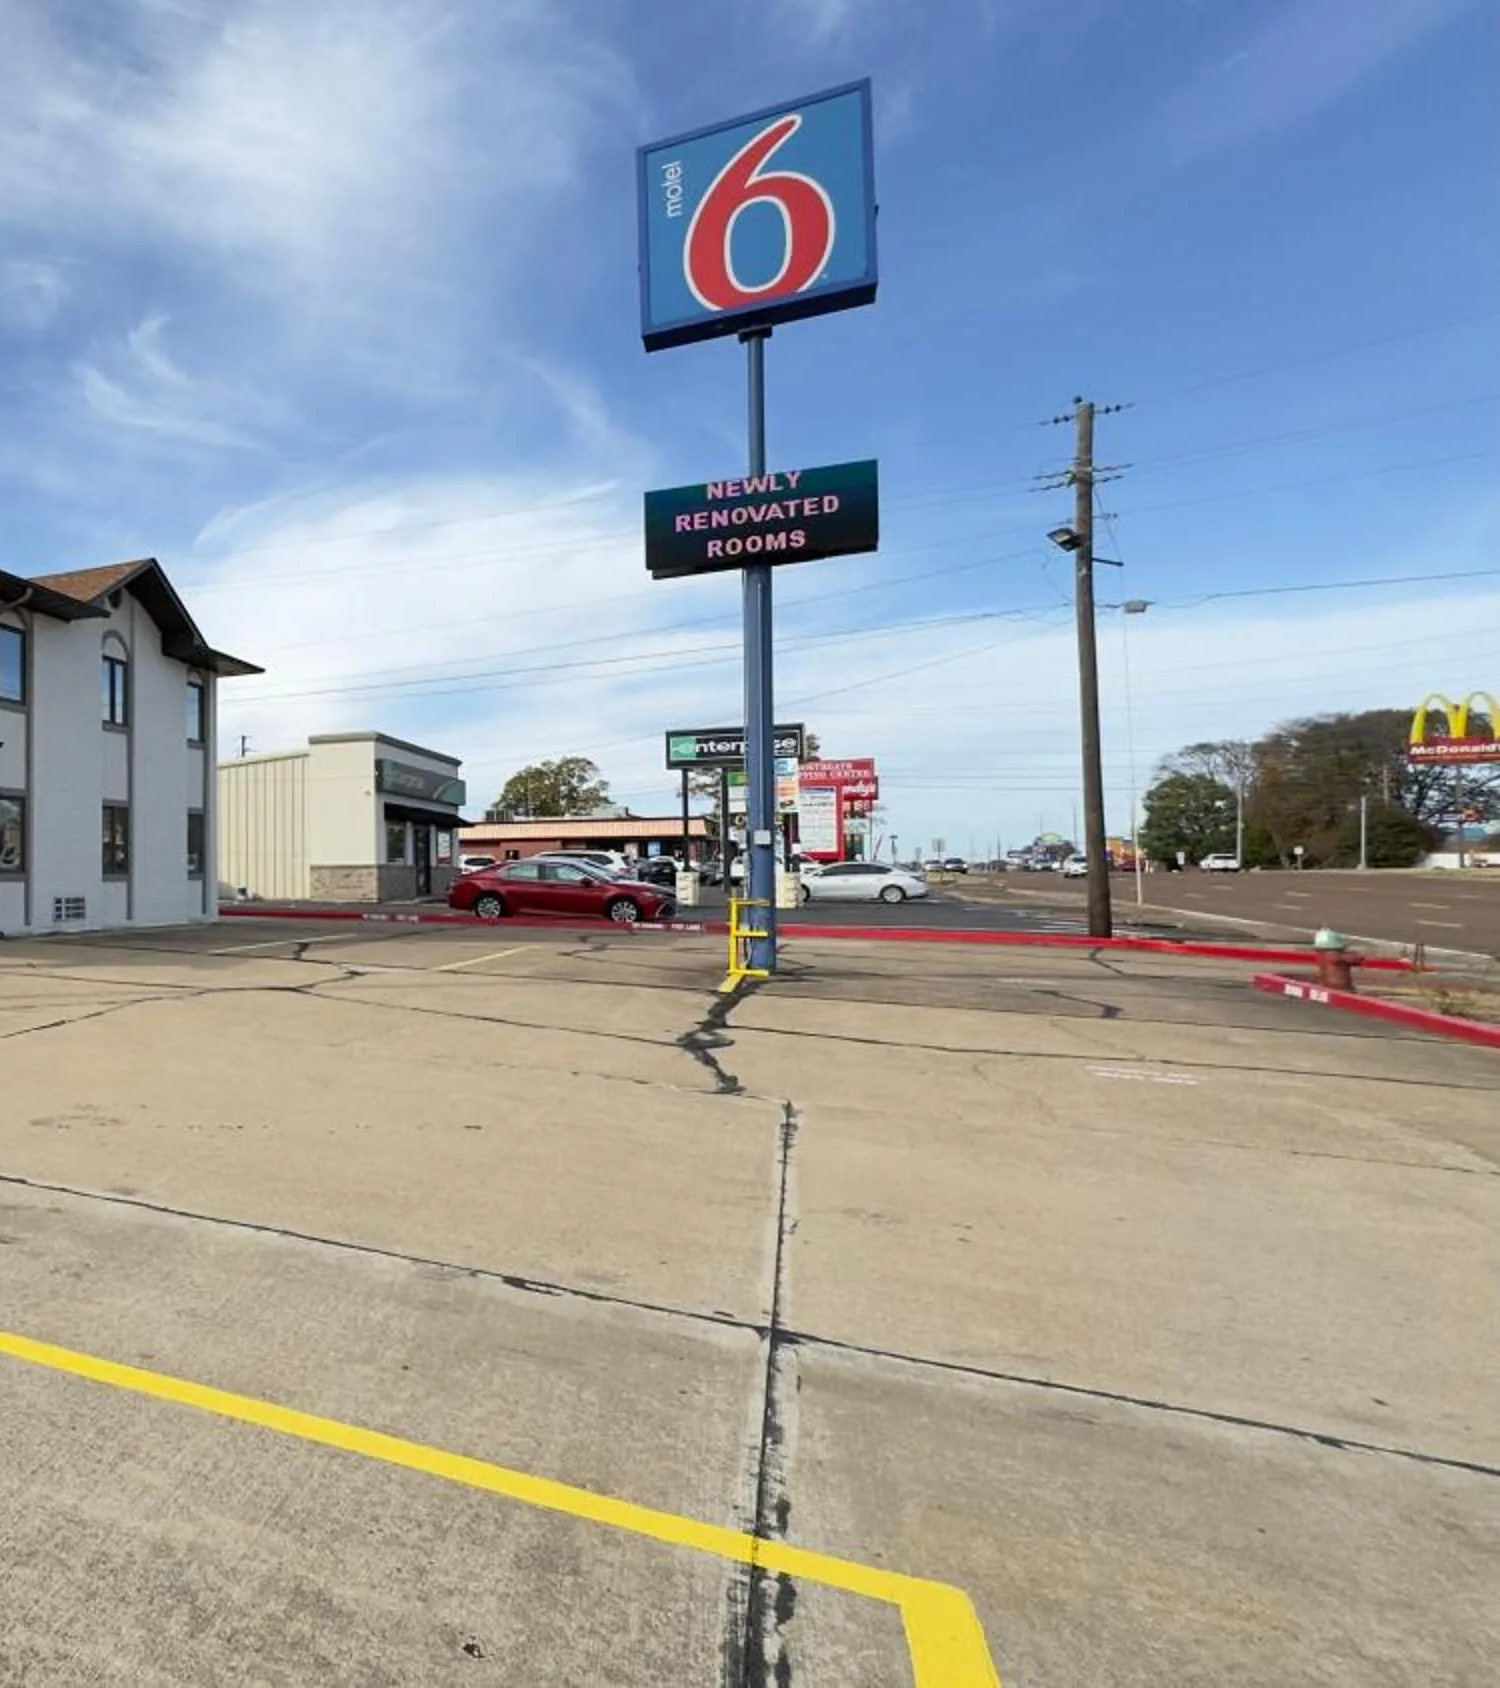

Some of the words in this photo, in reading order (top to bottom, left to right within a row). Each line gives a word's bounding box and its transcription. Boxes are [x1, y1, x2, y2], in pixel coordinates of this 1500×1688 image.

[661, 160, 683, 219] motel
[683, 113, 836, 311] 6
[706, 470, 802, 500] NEWLY
[675, 494, 840, 532] RENOVATED
[706, 529, 807, 558] ROOMS
[671, 738, 797, 755] enterse
